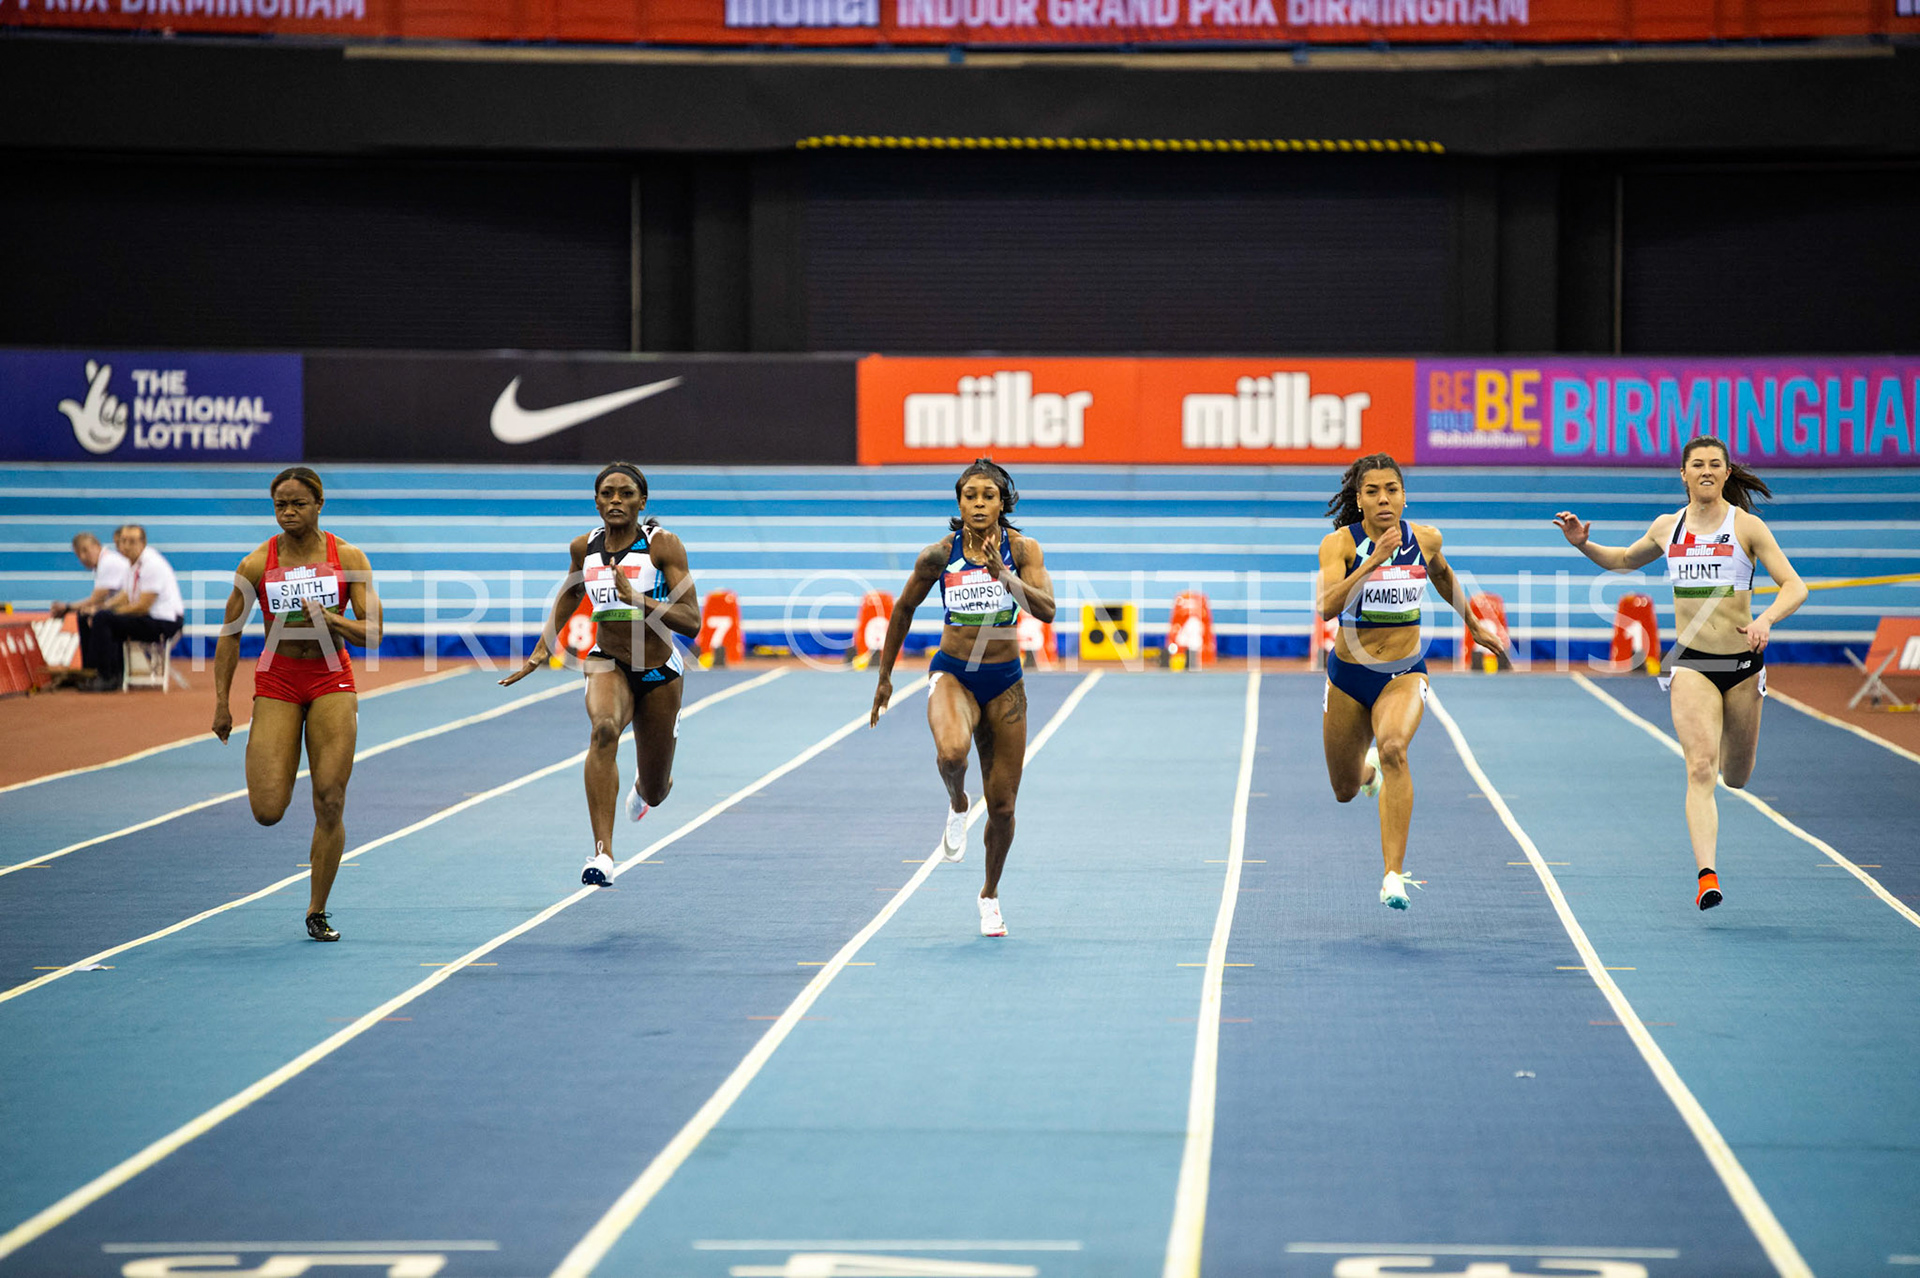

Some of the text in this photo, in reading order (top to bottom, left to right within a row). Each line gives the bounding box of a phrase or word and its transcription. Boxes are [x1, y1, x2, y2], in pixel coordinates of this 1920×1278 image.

[131, 370, 187, 395] THE
[1429, 371, 1472, 411] BE
[133, 397, 272, 424] NATIONAL
[904, 371, 1092, 448] müller
[1182, 372, 1371, 449] müller
[1475, 369, 1920, 456] BE BIRMINGHA
[134, 425, 254, 449] LOTTERY
[1686, 544, 1716, 556] müller
[284, 566, 317, 580] müller
[1382, 566, 1410, 580] müller
[1678, 563, 1721, 580] HUNT
[271, 592, 336, 610] BARTT
[281, 580, 323, 596] SMITH
[591, 586, 618, 604] NEIT
[567, 614, 594, 651] 8
[706, 615, 734, 648] 7
[1175, 616, 1203, 651] 4
[1624, 620, 1643, 651] 1
